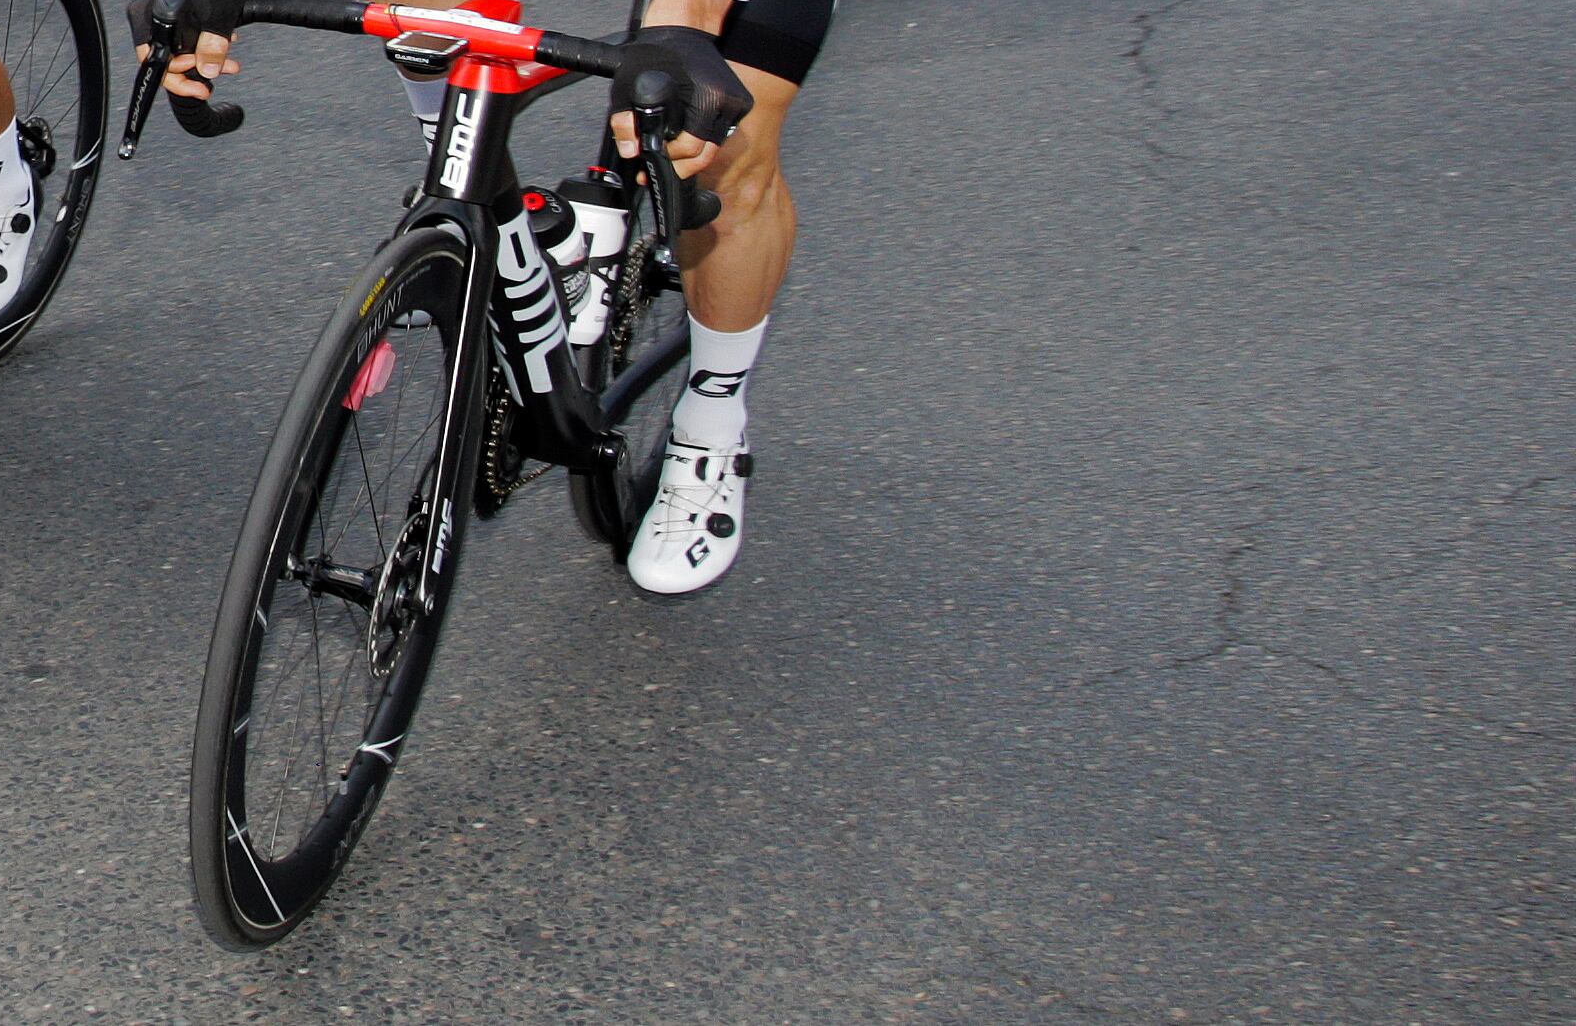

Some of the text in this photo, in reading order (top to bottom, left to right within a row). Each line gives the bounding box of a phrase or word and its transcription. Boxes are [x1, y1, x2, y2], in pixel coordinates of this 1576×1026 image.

[394, 53, 430, 64] GARMIN
[440, 92, 482, 190] BMC
[367, 282, 404, 351] HUNT
